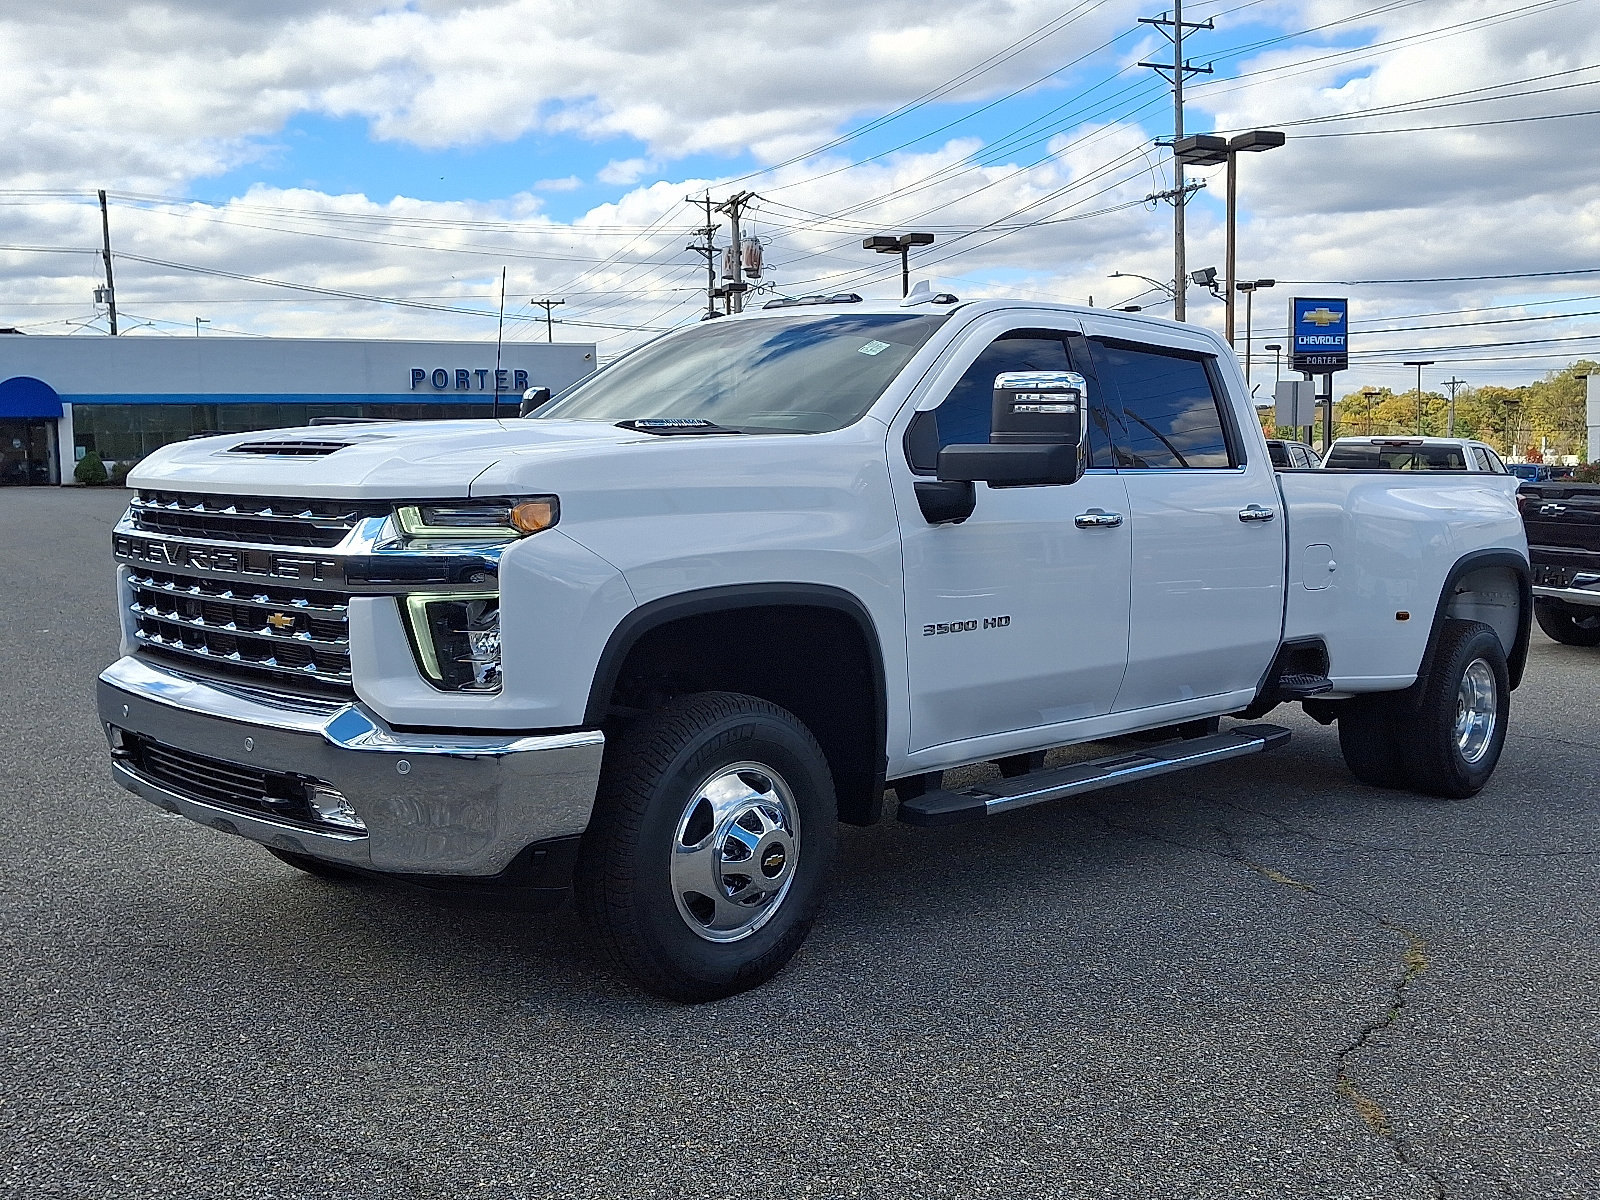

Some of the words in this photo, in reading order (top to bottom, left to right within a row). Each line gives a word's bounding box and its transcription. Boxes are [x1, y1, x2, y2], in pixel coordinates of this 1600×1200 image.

[1299, 336, 1345, 345] CHEVROLET
[1306, 356, 1337, 364] PORTER
[410, 367, 529, 390] PORTER
[114, 537, 336, 582] CHEVROLET
[923, 620, 977, 636] 3500
[983, 615, 1011, 630] HD
